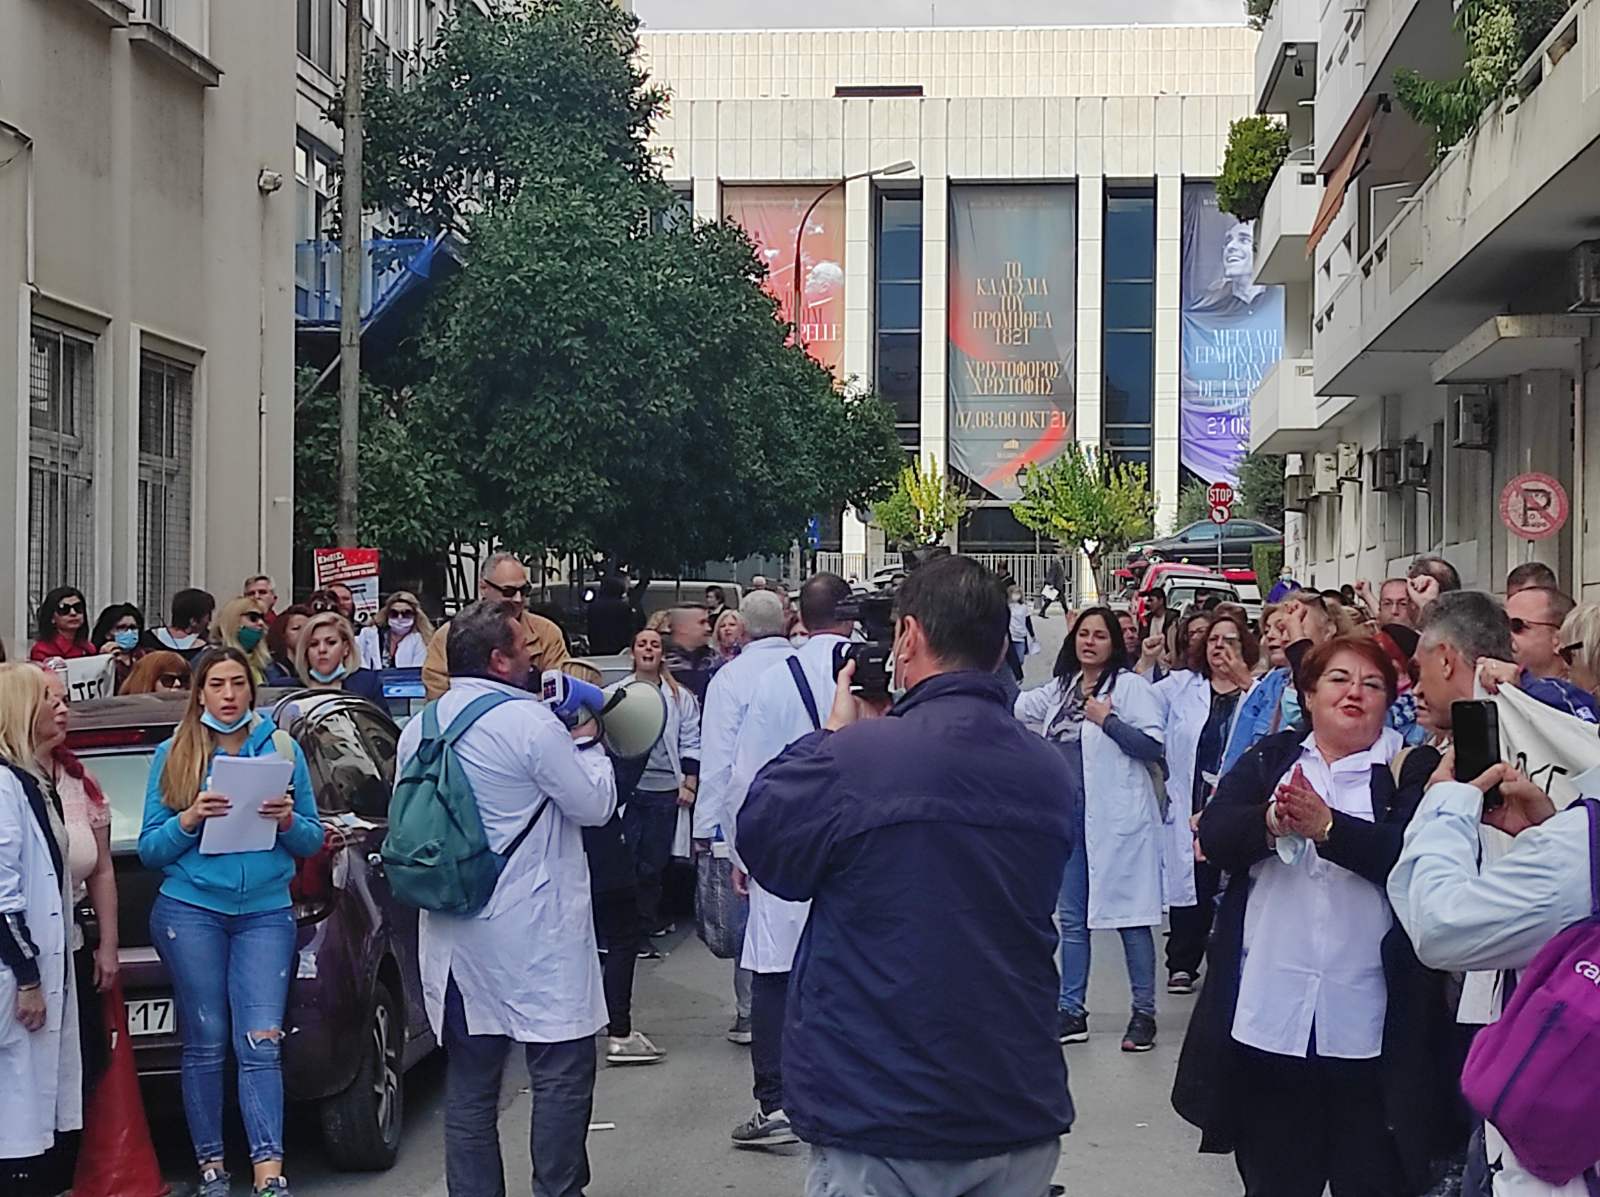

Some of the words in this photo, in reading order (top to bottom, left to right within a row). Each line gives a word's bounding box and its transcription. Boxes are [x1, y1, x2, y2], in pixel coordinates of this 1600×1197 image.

[1005, 261, 1022, 279] ΤΟ
[976, 278, 1048, 295] ΚΑΛΕΣΜΑ
[1000, 294, 1024, 313] ΤΟΥ
[972, 311, 1052, 329] ΠΡΟΜΗΘΕΑ
[994, 328, 1031, 346] 1821
[1213, 328, 1278, 346] ΜΕΓΑΛΟΙ
[965, 360, 1062, 379] ΧΡΙΣΤΟΦΟΡΟΣ
[972, 376, 1055, 396] ΧΡΙΣΤΟΦΗΣ
[1210, 488, 1232, 502] STOP
